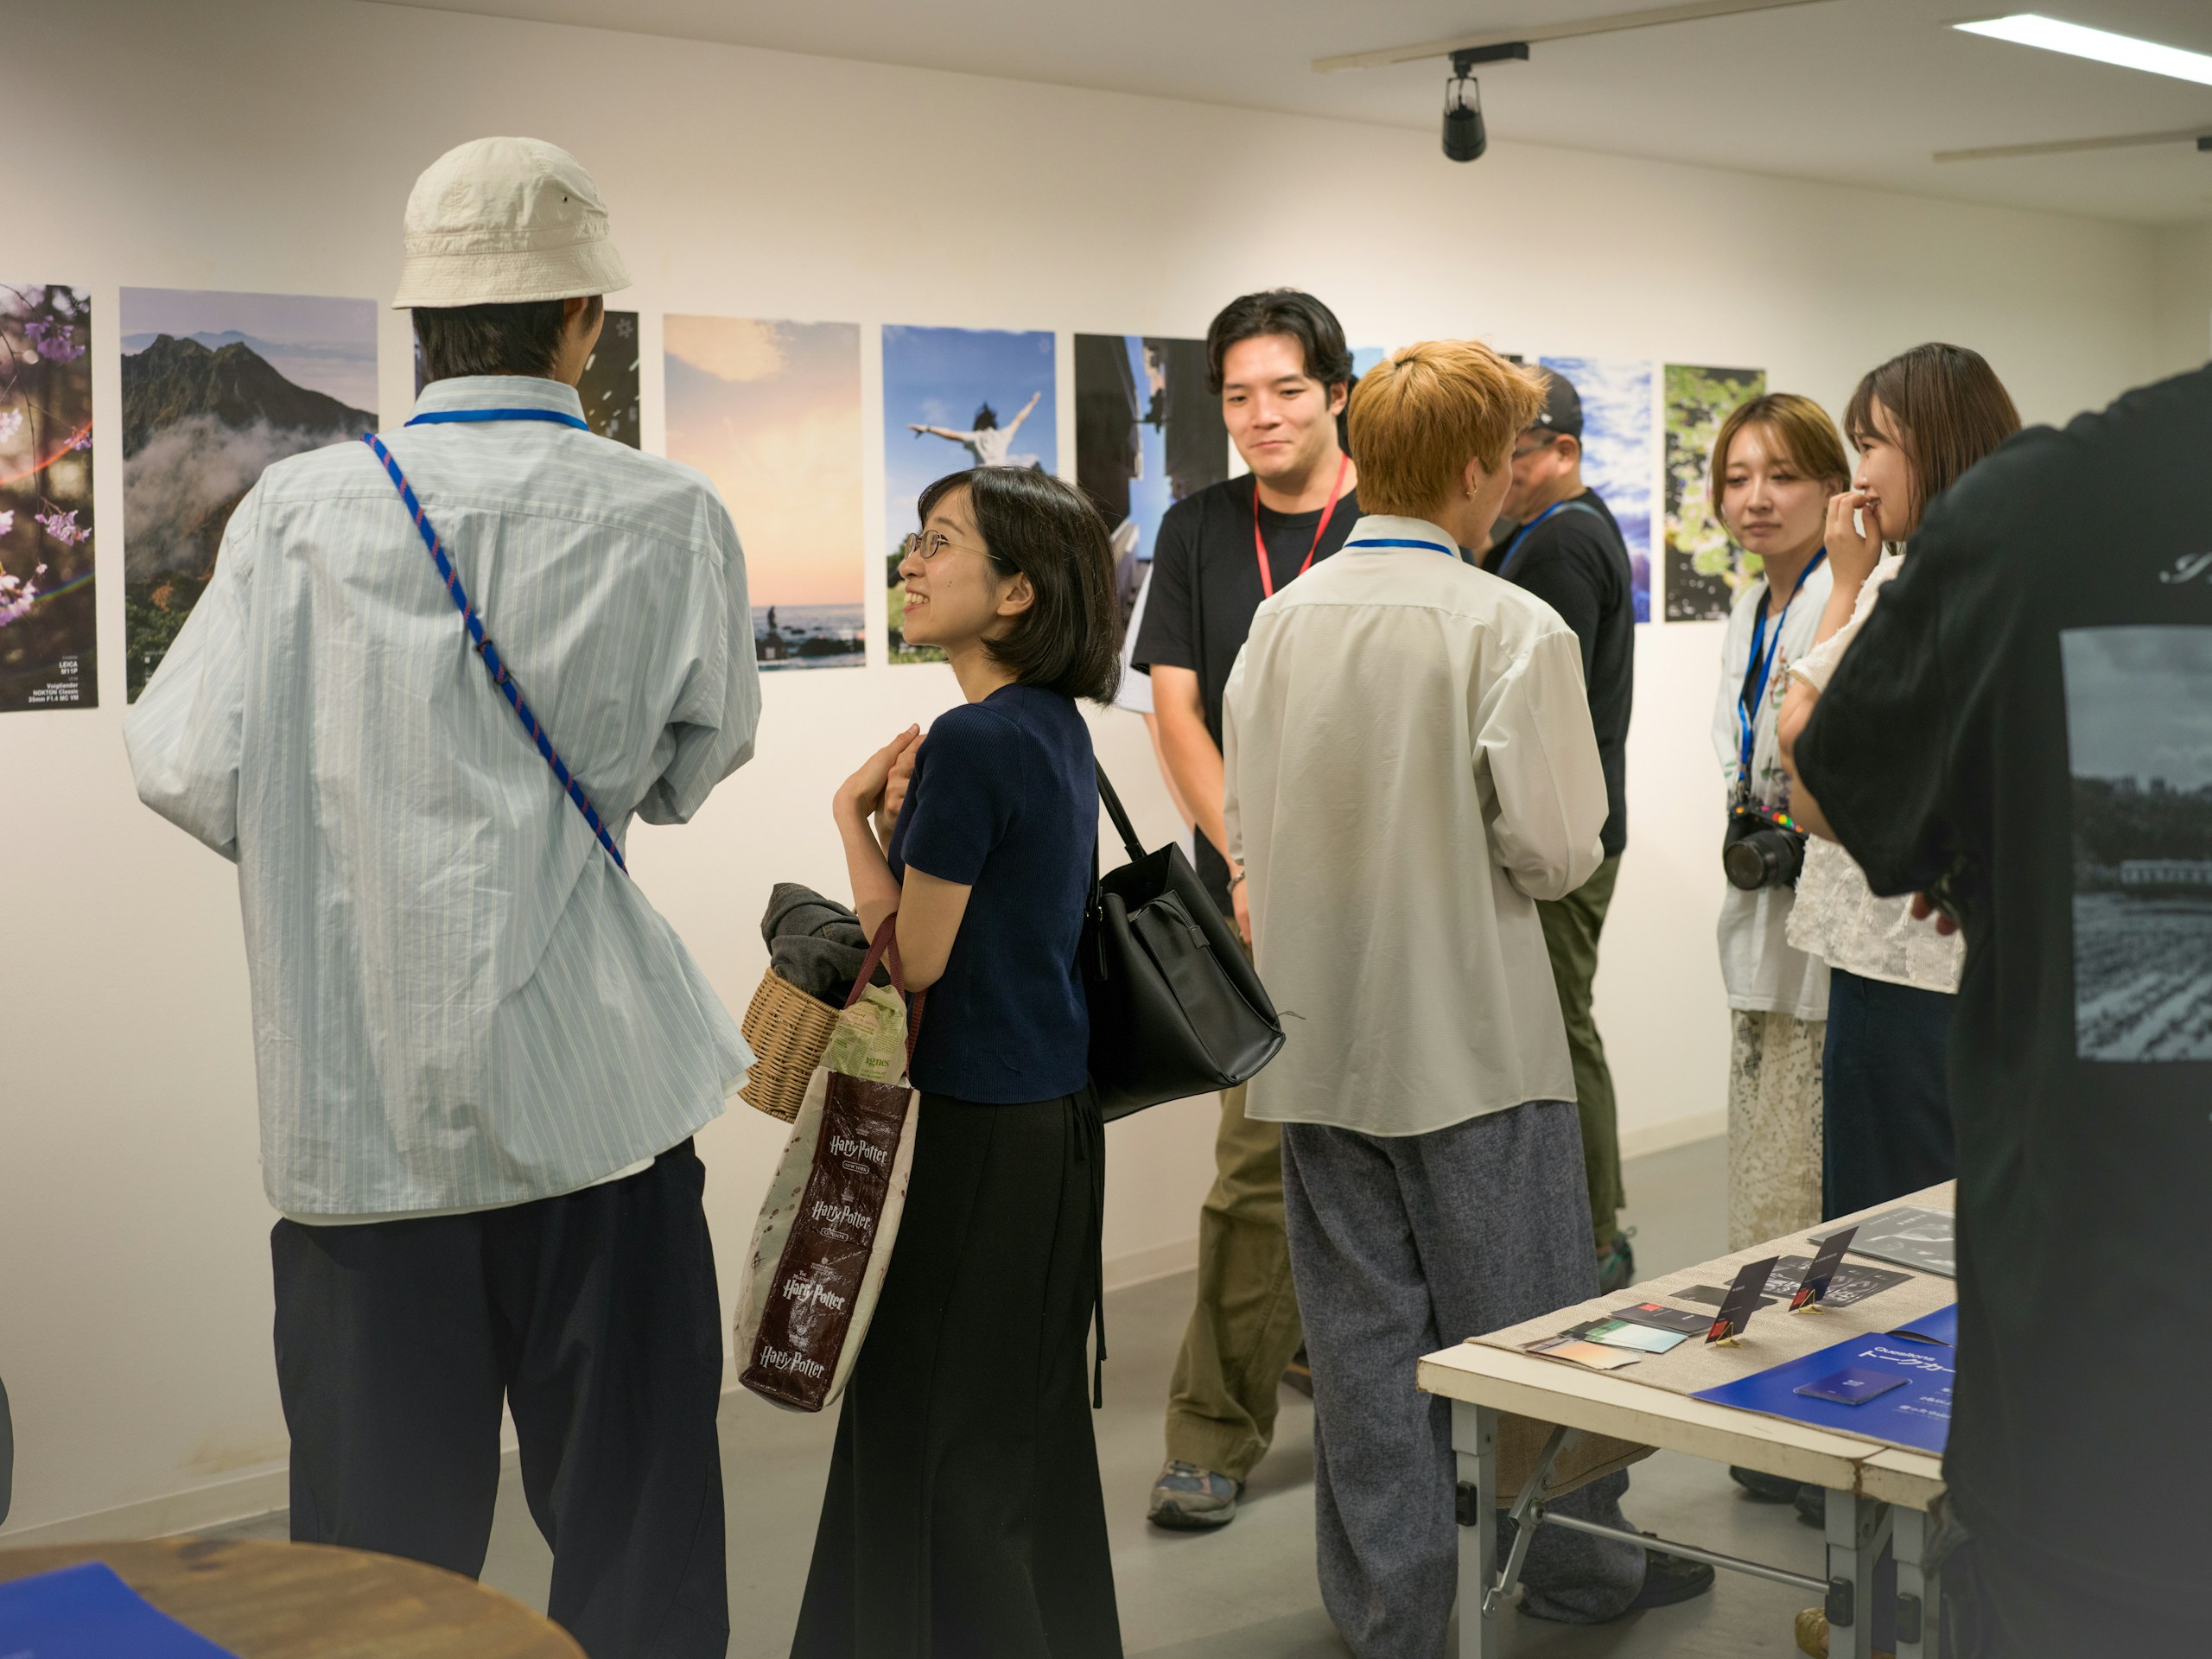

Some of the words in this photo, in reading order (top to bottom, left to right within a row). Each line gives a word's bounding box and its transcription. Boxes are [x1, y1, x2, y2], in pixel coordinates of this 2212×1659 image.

[830, 1135, 859, 1157] Harry
[857, 1140, 887, 1163] Potter
[812, 1201, 842, 1222] Harry
[840, 1205, 871, 1229] Potter
[783, 1279, 814, 1302] Harry
[810, 1283, 845, 1311] Potter
[760, 1345, 791, 1370] Harry
[789, 1351, 824, 1379] Potter
